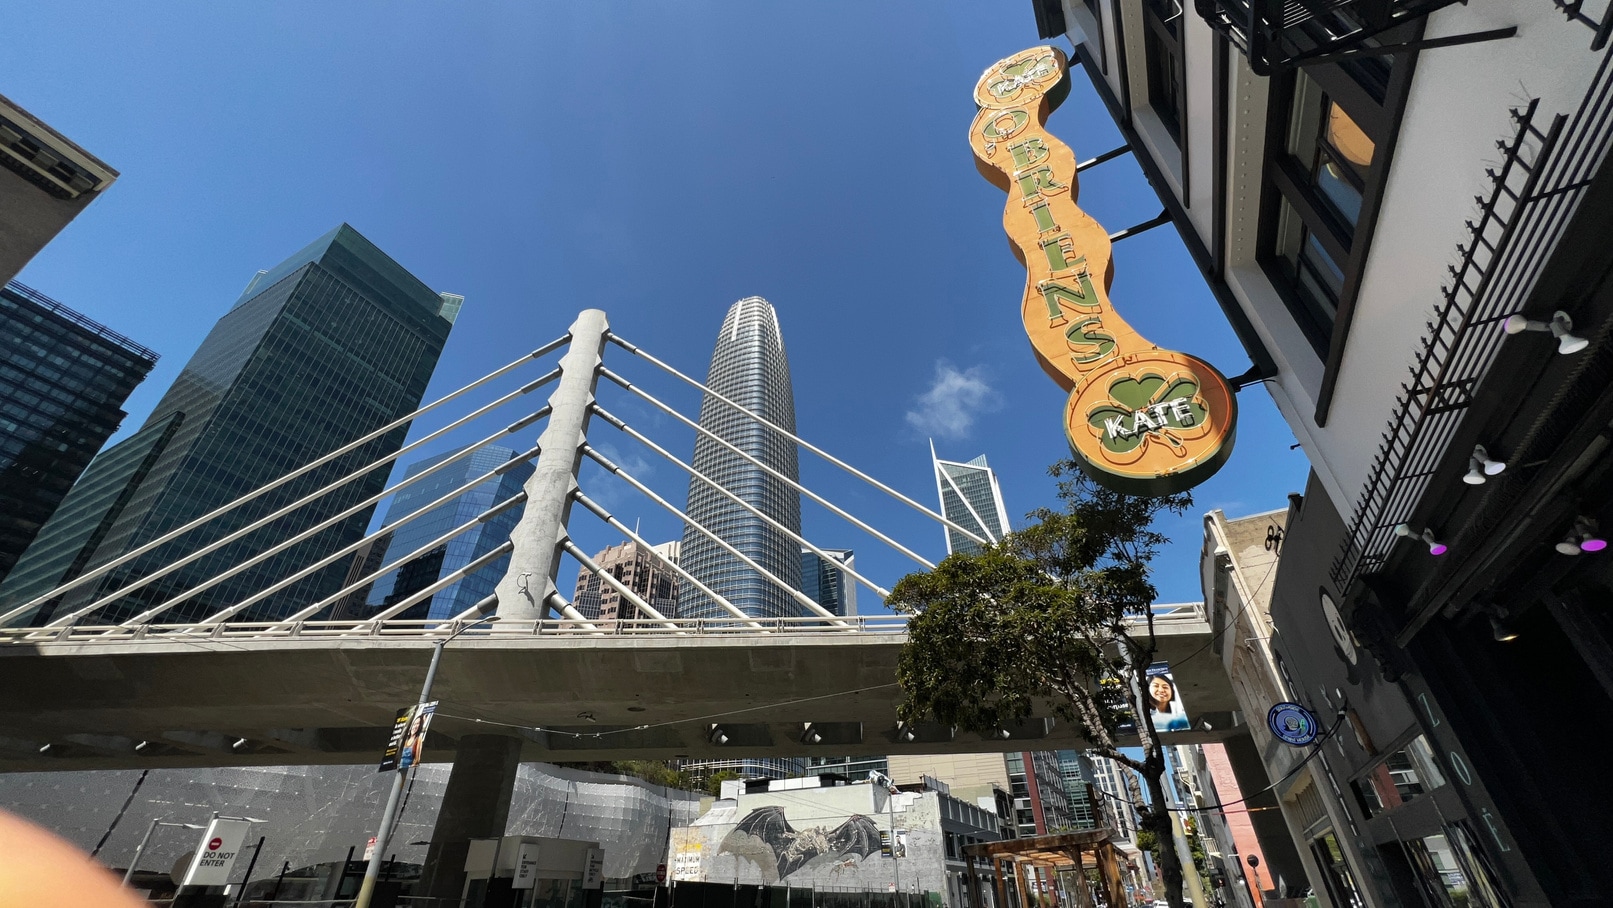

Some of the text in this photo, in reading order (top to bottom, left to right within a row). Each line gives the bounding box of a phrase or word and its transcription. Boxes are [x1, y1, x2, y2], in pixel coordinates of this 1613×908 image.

[996, 63, 1049, 95] KATE
[1103, 396, 1194, 440] KATE
[203, 851, 235, 860] DO NOT
[200, 859, 225, 867] ENTER
[676, 866, 699, 875] SPEED
